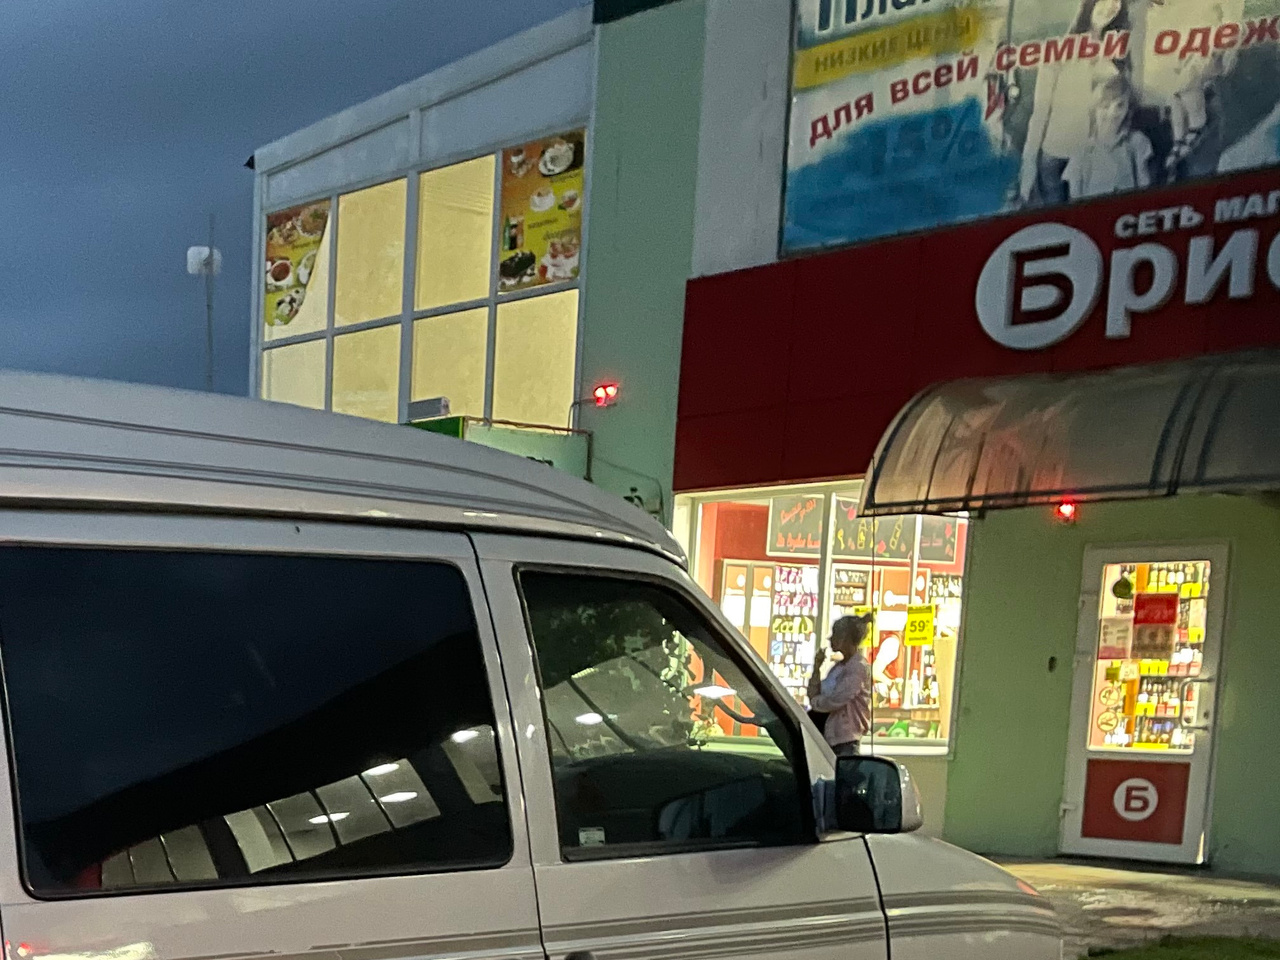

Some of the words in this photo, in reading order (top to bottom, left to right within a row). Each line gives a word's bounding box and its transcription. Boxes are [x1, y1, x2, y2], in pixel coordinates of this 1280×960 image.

[809, 92, 874, 148] для
[890, 49, 979, 106] всей
[995, 31, 1131, 72] семьи
[1114, 205, 1205, 238] СЕТЬ
[978, 222, 1280, 350] Бри
[1123, 785, 1150, 813] Б
